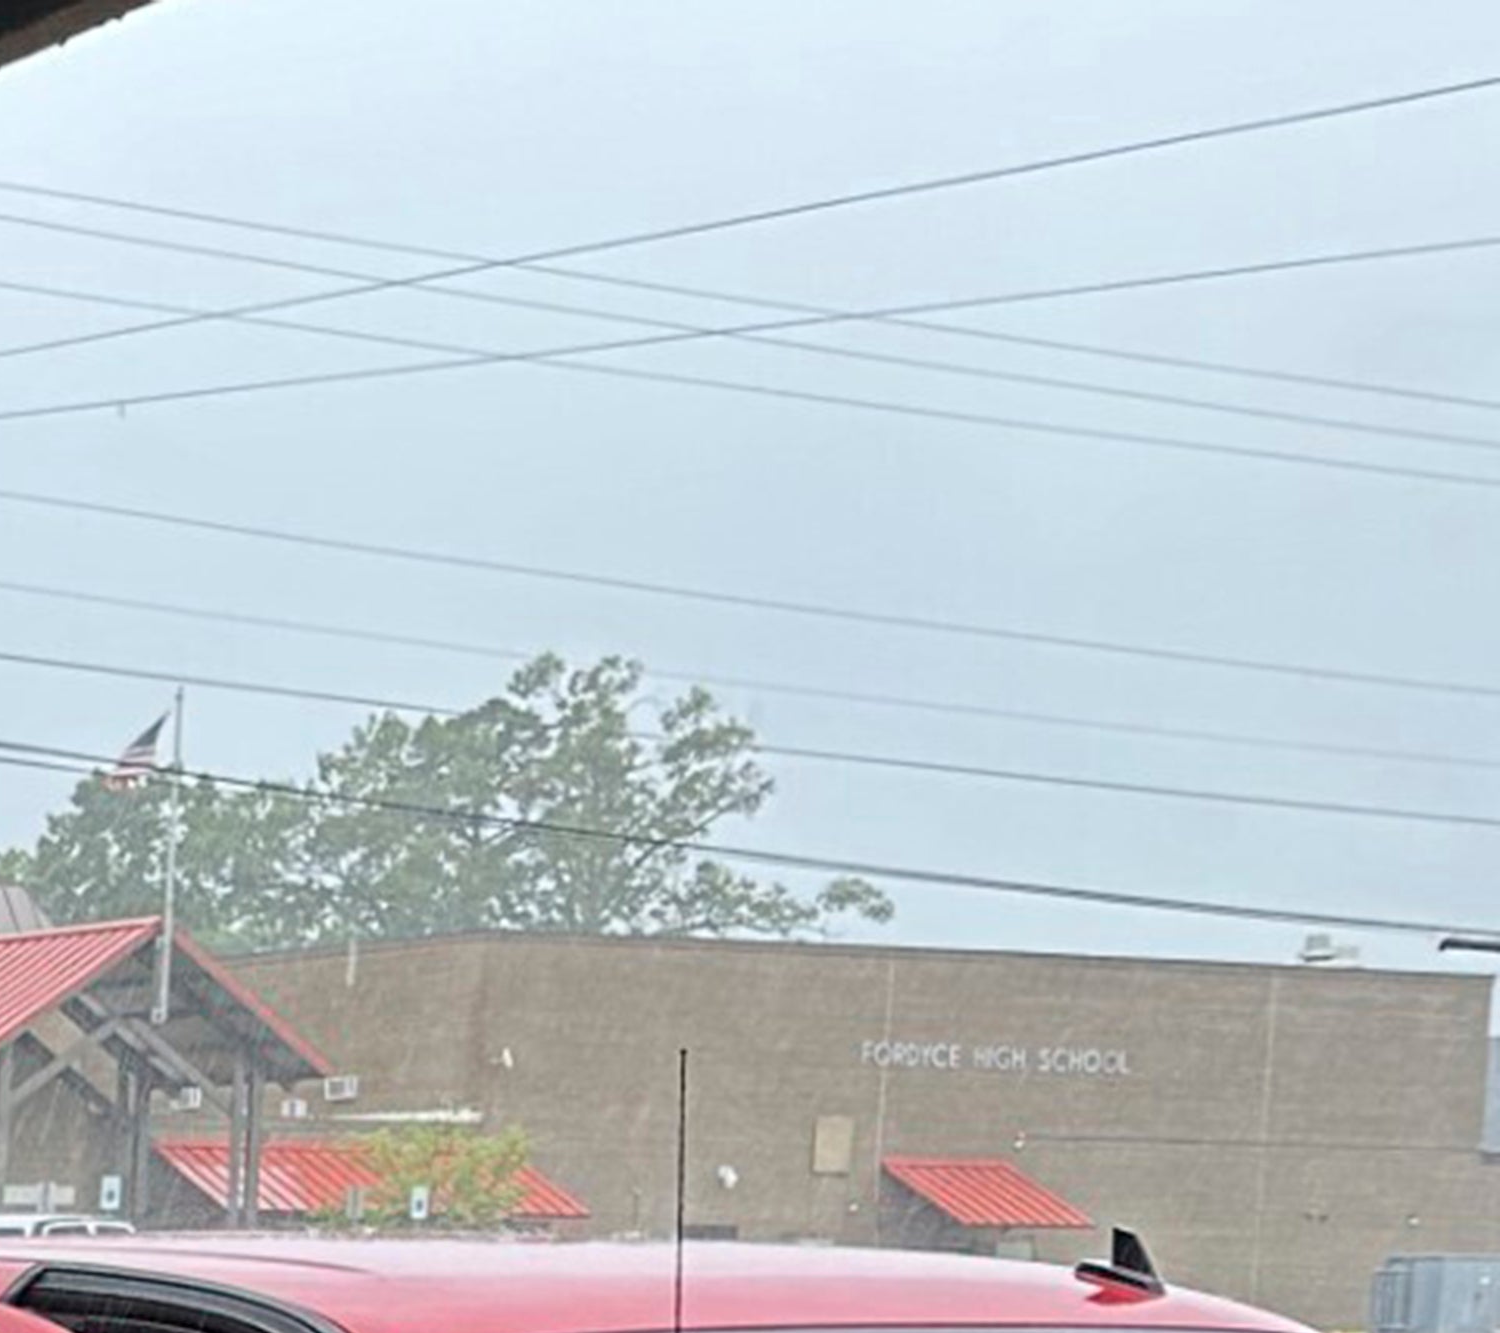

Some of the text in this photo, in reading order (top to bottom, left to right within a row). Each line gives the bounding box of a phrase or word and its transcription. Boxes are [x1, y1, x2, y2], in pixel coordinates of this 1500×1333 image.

[861, 1039, 1131, 1075] FORDYCE HIGH SCHOOL
